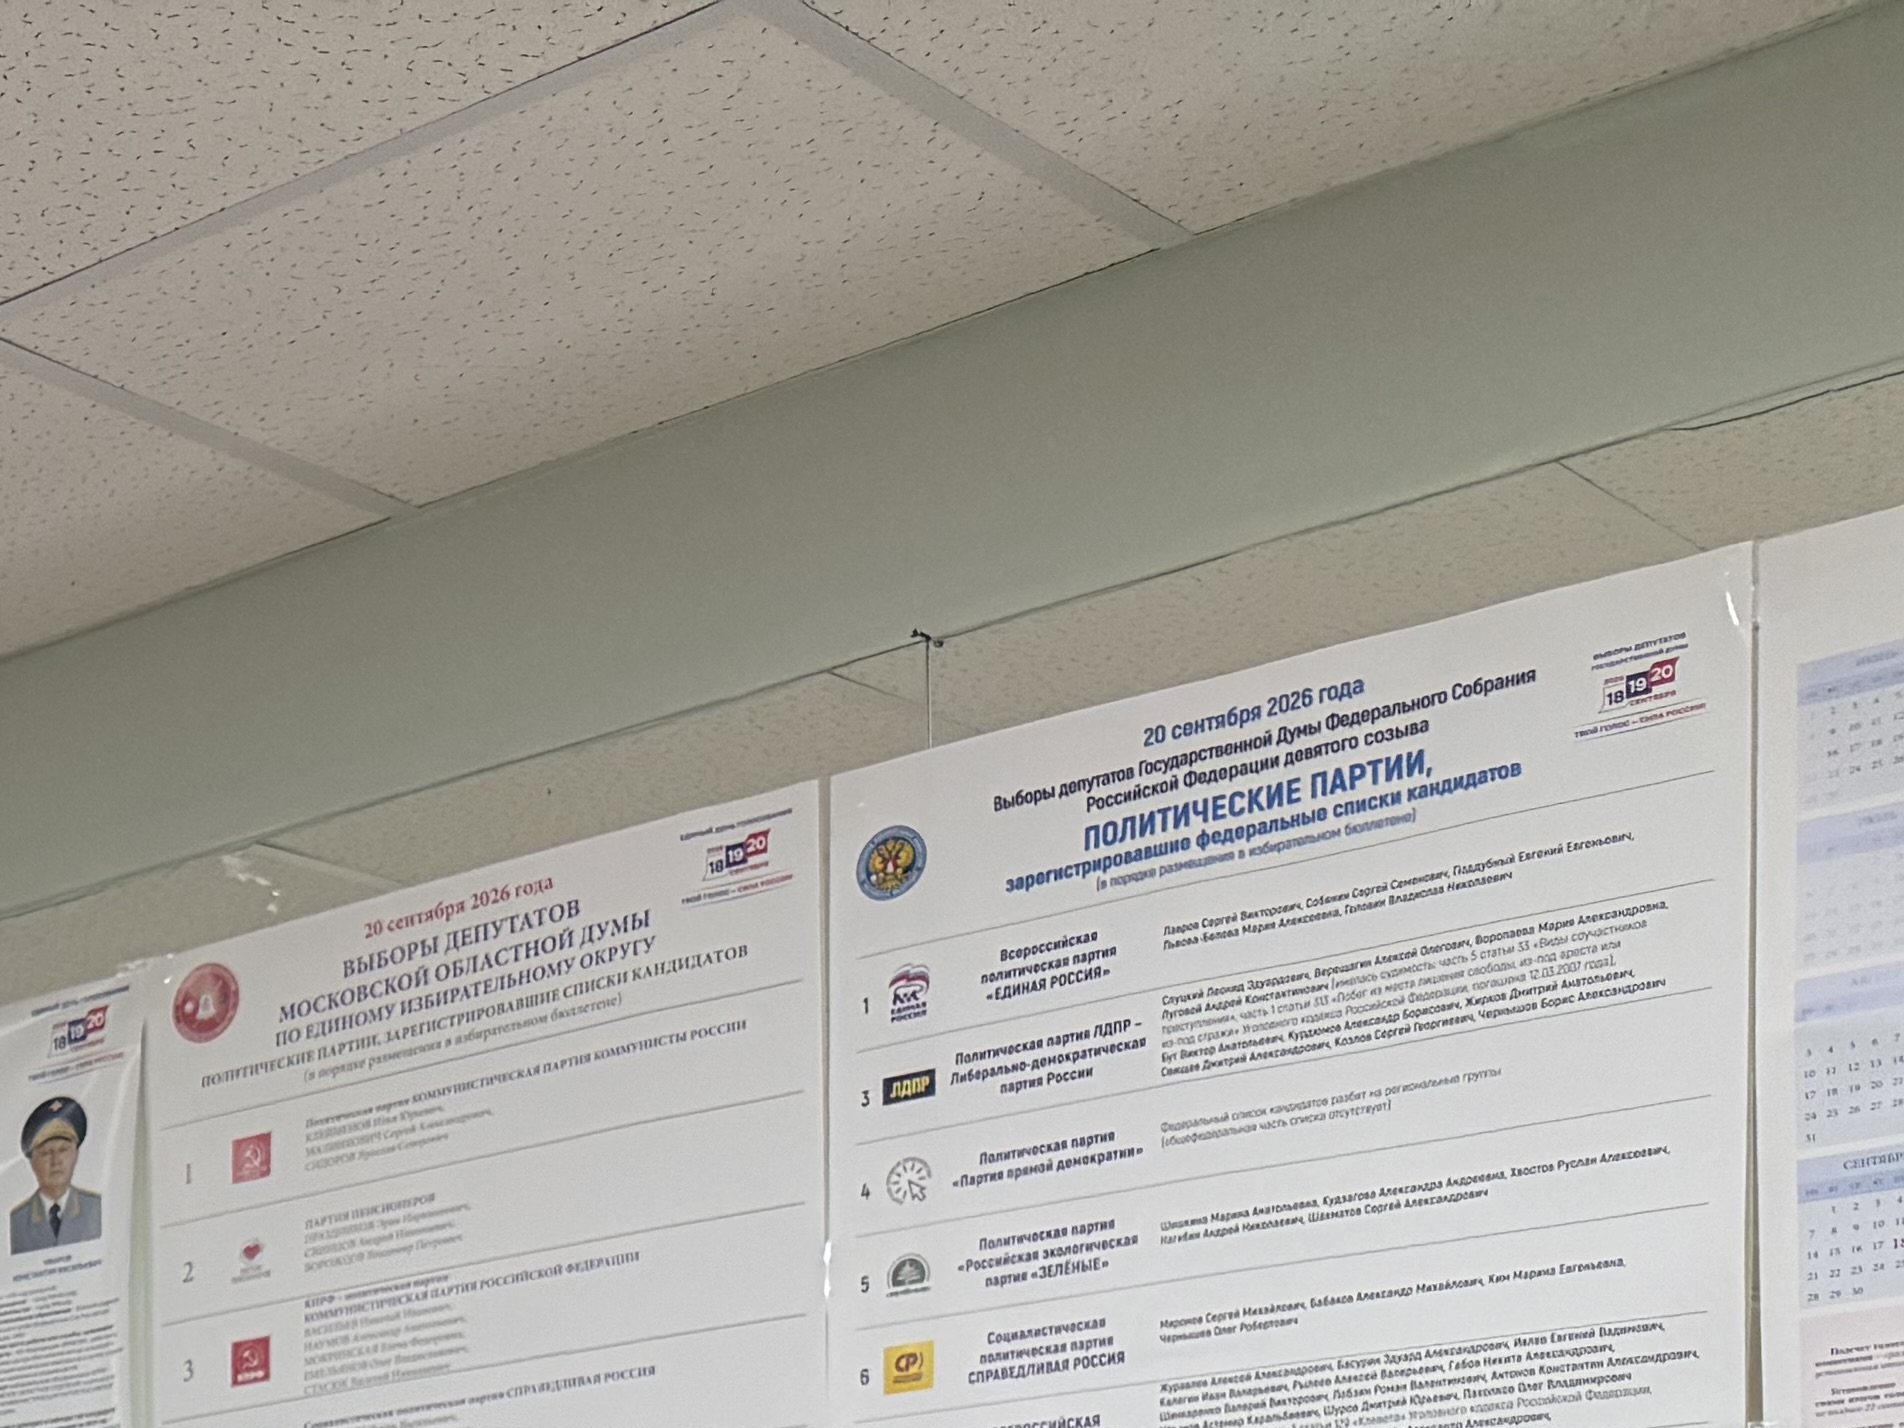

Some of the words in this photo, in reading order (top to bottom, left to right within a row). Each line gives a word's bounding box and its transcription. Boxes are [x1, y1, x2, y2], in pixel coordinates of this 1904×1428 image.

[1606, 690, 1625, 706] 18
[1628, 677, 1647, 693] 19
[1651, 664, 1673, 682] 20
[1143, 723, 1167, 748] 20
[1170, 704, 1262, 740] сентября
[1266, 686, 1314, 718] 2026
[1318, 678, 1365, 705] года
[993, 785, 1056, 813] Выборы
[1057, 765, 1135, 800] депутатов
[1138, 728, 1273, 778] Государственной
[1275, 719, 1322, 747] Думы
[1324, 689, 1448, 732] Федерального
[1450, 668, 1537, 701] Собрания
[1085, 773, 1179, 813] Российской
[1182, 754, 1280, 789] Федерации
[1282, 735, 1359, 769] девятого
[1363, 718, 1430, 747] созыва
[1083, 776, 1302, 852] ПОЛИТИЧЕСКИЕ
[1310, 748, 1433, 800] ПАРТИИ,
[1004, 836, 1192, 893] зарегистрировавшие
[1195, 806, 1328, 852] федеральные
[1332, 789, 1402, 818] списки
[1406, 761, 1522, 803] кандидатов
[708, 860, 724, 874] 18
[728, 848, 744, 863] 19
[747, 836, 766, 853] 20
[363, 919, 384, 939] 20
[386, 899, 466, 933] сентября
[469, 883, 511, 911] 2026
[514, 876, 554, 899] года
[342, 935, 439, 979] ВЫБОРЫ
[443, 898, 581, 956] ДЕПУТАТОВ
[999, 930, 1098, 962] Всероссийская
[278, 964, 429, 1023] МОСКОВСКОЙ
[434, 926, 574, 982] ОБЛАСТНОЙ
[578, 908, 650, 950] ДУМЫ
[980, 955, 1070, 985] политическая
[1071, 945, 1117, 966] партия
[275, 1027, 302, 1048] ПО
[305, 1002, 396, 1040] ЕДИНОМУ
[399, 955, 576, 1016] ИЗБИРАТЕЛЬНОМУ
[578, 934, 656, 970] ОКРУГУ
[985, 977, 1047, 1001] «ЕДИНАЯ
[1049, 965, 1111, 989] РОССИЯ»
[200, 1049, 315, 1088] ПОЛИТИЧЕСКИЕ
[317, 1033, 382, 1061] ПАРТИИ,
[385, 987, 560, 1044] ЗАРЕГИСТРИРОВАВШИЕ
[561, 970, 628, 999] СПИСКИ
[631, 944, 748, 982] КАНДИДАТОВ
[862, 996, 869, 1015] 1
[954, 1037, 1044, 1066] Политическая
[1045, 1028, 1091, 1048] партия
[1092, 1018, 1132, 1039] ЛДПР
[949, 1036, 1147, 1086] Либерально-демократическая
[890, 1076, 930, 1098] ЛДПР
[999, 1075, 1044, 1094] партия
[1046, 1066, 1094, 1086] России
[860, 1089, 870, 1108] 3
[185, 1162, 192, 1185] 1
[951, 1169, 1004, 1188] «Партия
[1006, 1157, 1054, 1181] прямой
[1055, 1146, 1144, 1173] демократии»
[1843, 1152, 1904, 1170] СЕНТЯБР
[860, 1182, 871, 1200] 4
[978, 1226, 1068, 1251] Политическая
[1070, 1218, 1115, 1236] партия
[957, 1249, 1040, 1273] «Российская
[1041, 1234, 1139, 1261] экологическая
[1807, 1251, 1819, 1260] 14
[181, 1260, 195, 1284] 2
[860, 1274, 870, 1294] 5
[984, 1270, 1028, 1288] партия
[1030, 1256, 1110, 1280] «ЗЕЛЁНЫЕ»
[1807, 1272, 1819, 1281] 21
[986, 1316, 1107, 1345] Социалистическая
[967, 1357, 1070, 1385] СПРАВЕДЛИВАЯ
[1072, 1350, 1126, 1371] РОССИЯ
[979, 1341, 1068, 1365] политическая
[1069, 1335, 1114, 1353] партия
[182, 1358, 195, 1383] 3
[859, 1367, 870, 1386] 6
